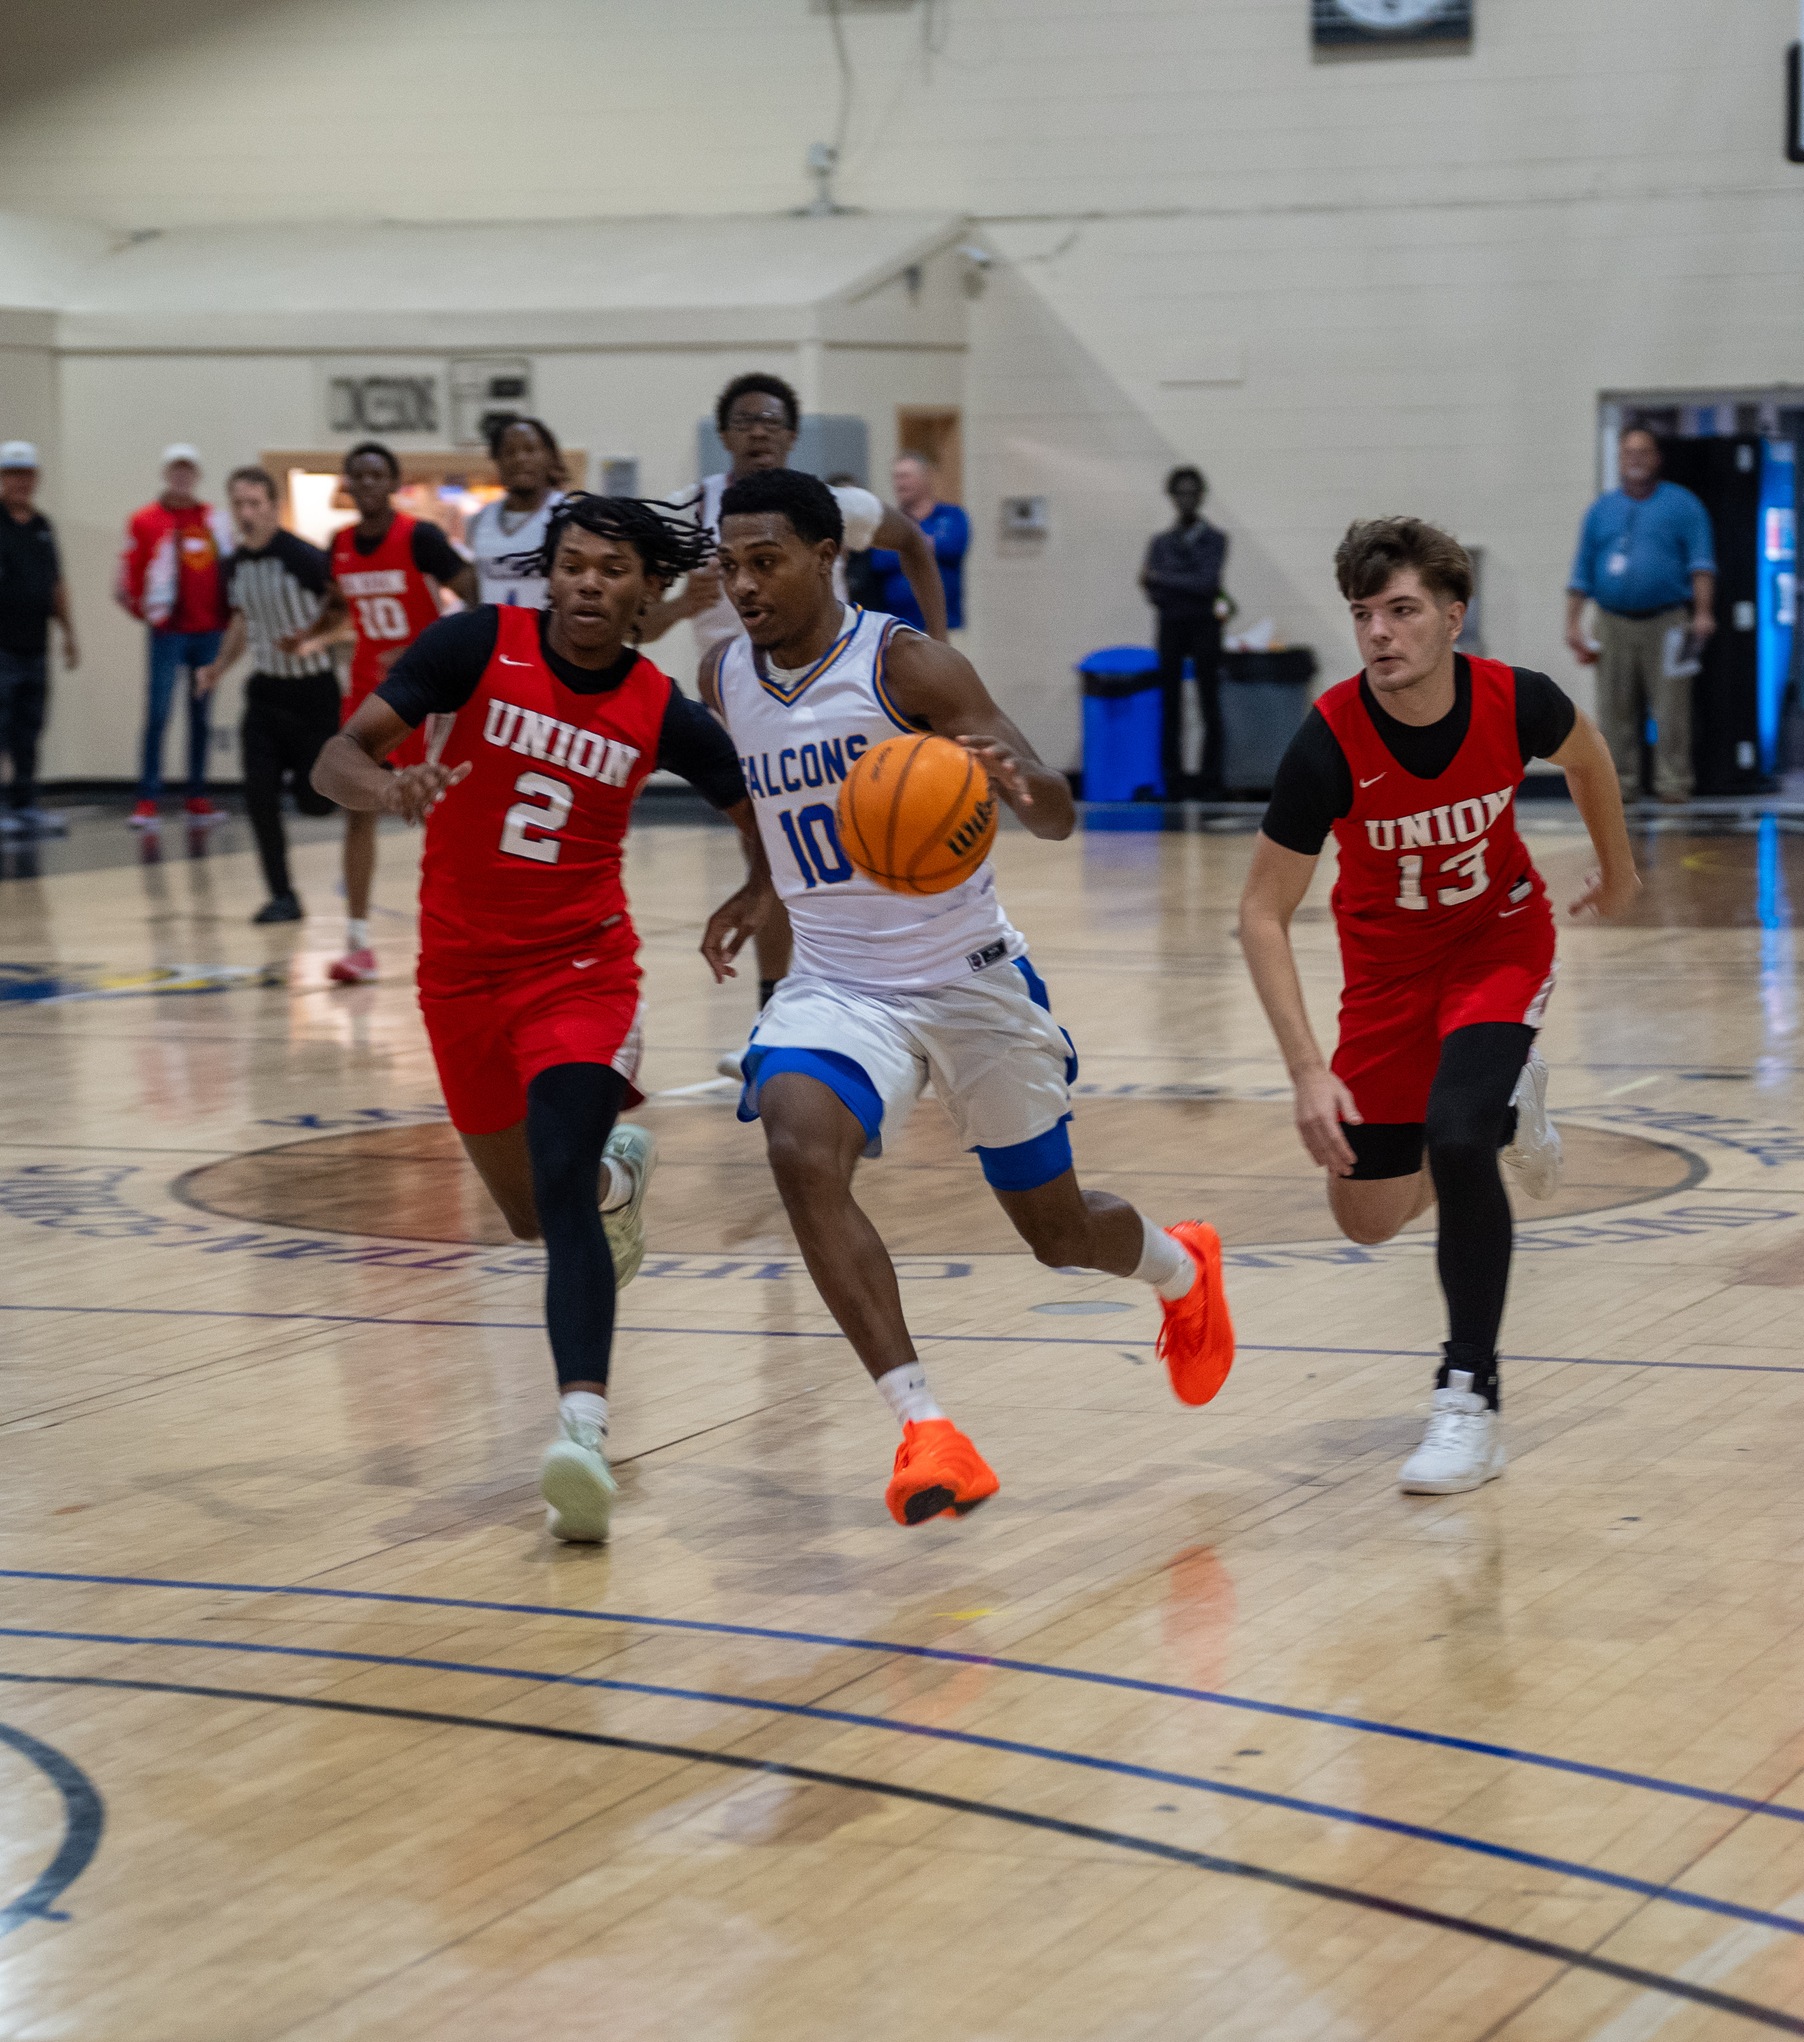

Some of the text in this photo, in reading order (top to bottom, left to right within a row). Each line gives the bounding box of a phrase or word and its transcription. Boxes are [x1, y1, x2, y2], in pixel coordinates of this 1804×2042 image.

[355, 597, 410, 641] 10
[483, 697, 640, 788] UNION
[499, 770, 574, 864] 2
[778, 803, 855, 889] 10
[1364, 785, 1514, 851] UNION
[1395, 837, 1490, 911] 13
